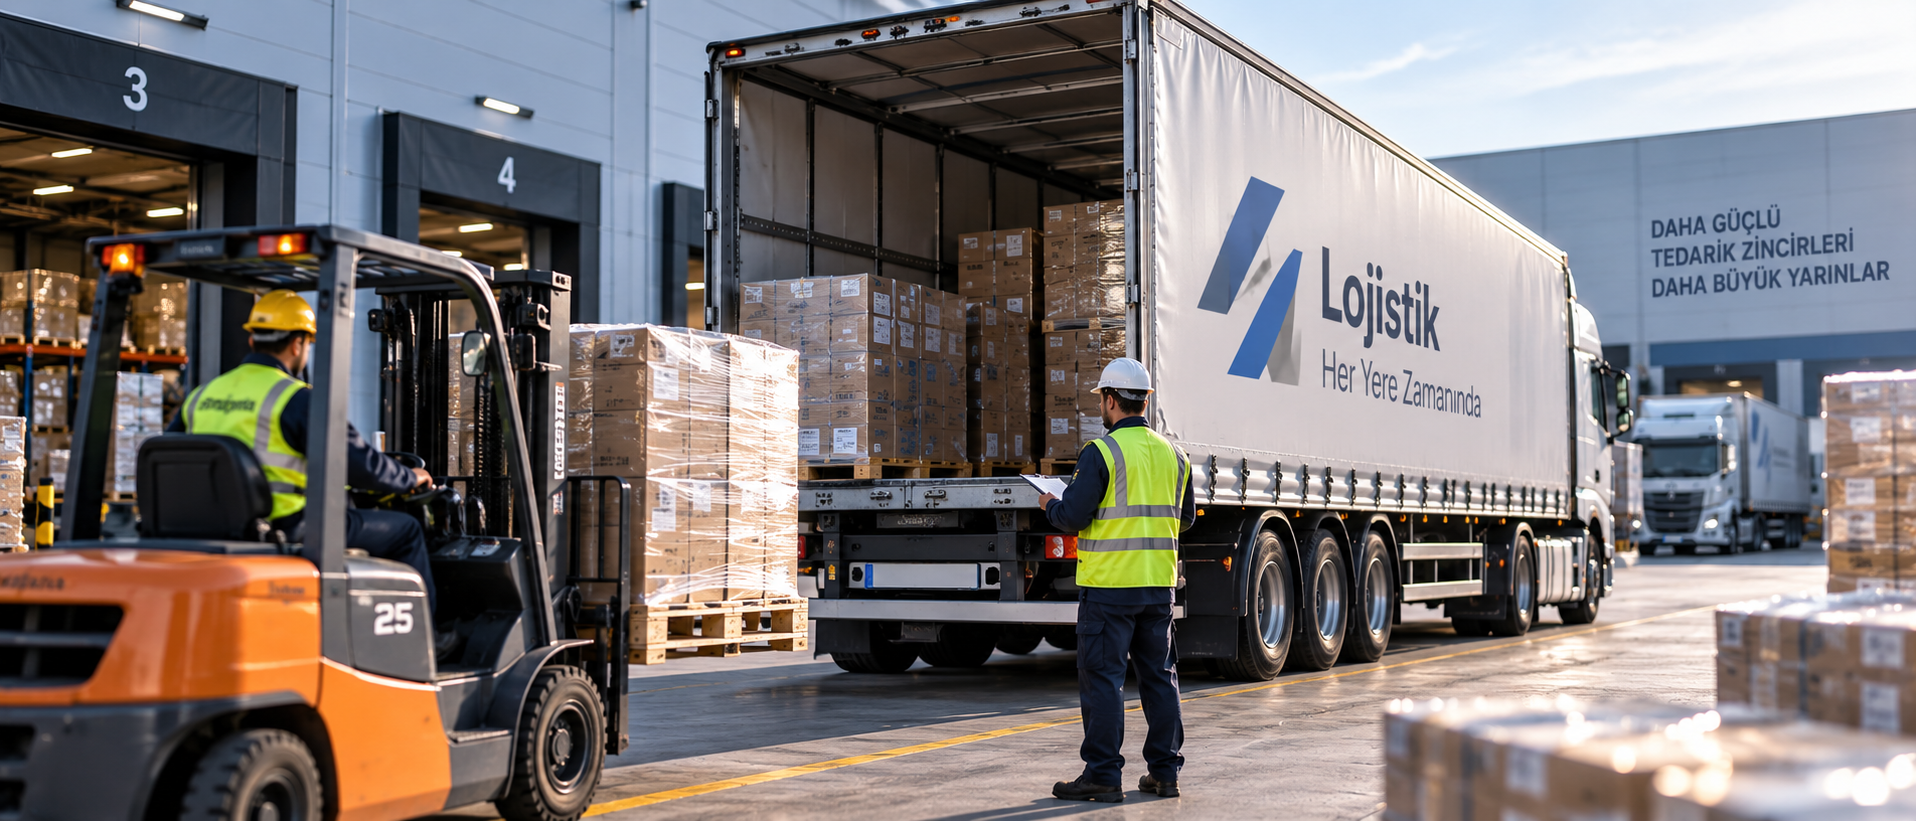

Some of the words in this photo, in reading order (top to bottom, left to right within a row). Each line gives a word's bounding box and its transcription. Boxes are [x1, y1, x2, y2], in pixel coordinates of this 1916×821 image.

[122, 66, 148, 112] 3
[497, 156, 517, 194] 4
[1651, 215, 1707, 239] DAHA
[1712, 203, 1781, 236] GÜÇLÜ
[1650, 238, 1737, 268] TEDARİK
[1741, 227, 1854, 261] ZİNCİRLERİ
[1651, 274, 1708, 298] DAHA
[1713, 265, 1782, 294] BÜYÜK
[1787, 260, 1890, 288] YARINLAR
[1321, 246, 1441, 352] Lojistik
[1322, 348, 1356, 393] Her
[1360, 358, 1398, 403] Yere
[1402, 369, 1482, 418] Zamanında
[373, 602, 414, 636] 25
